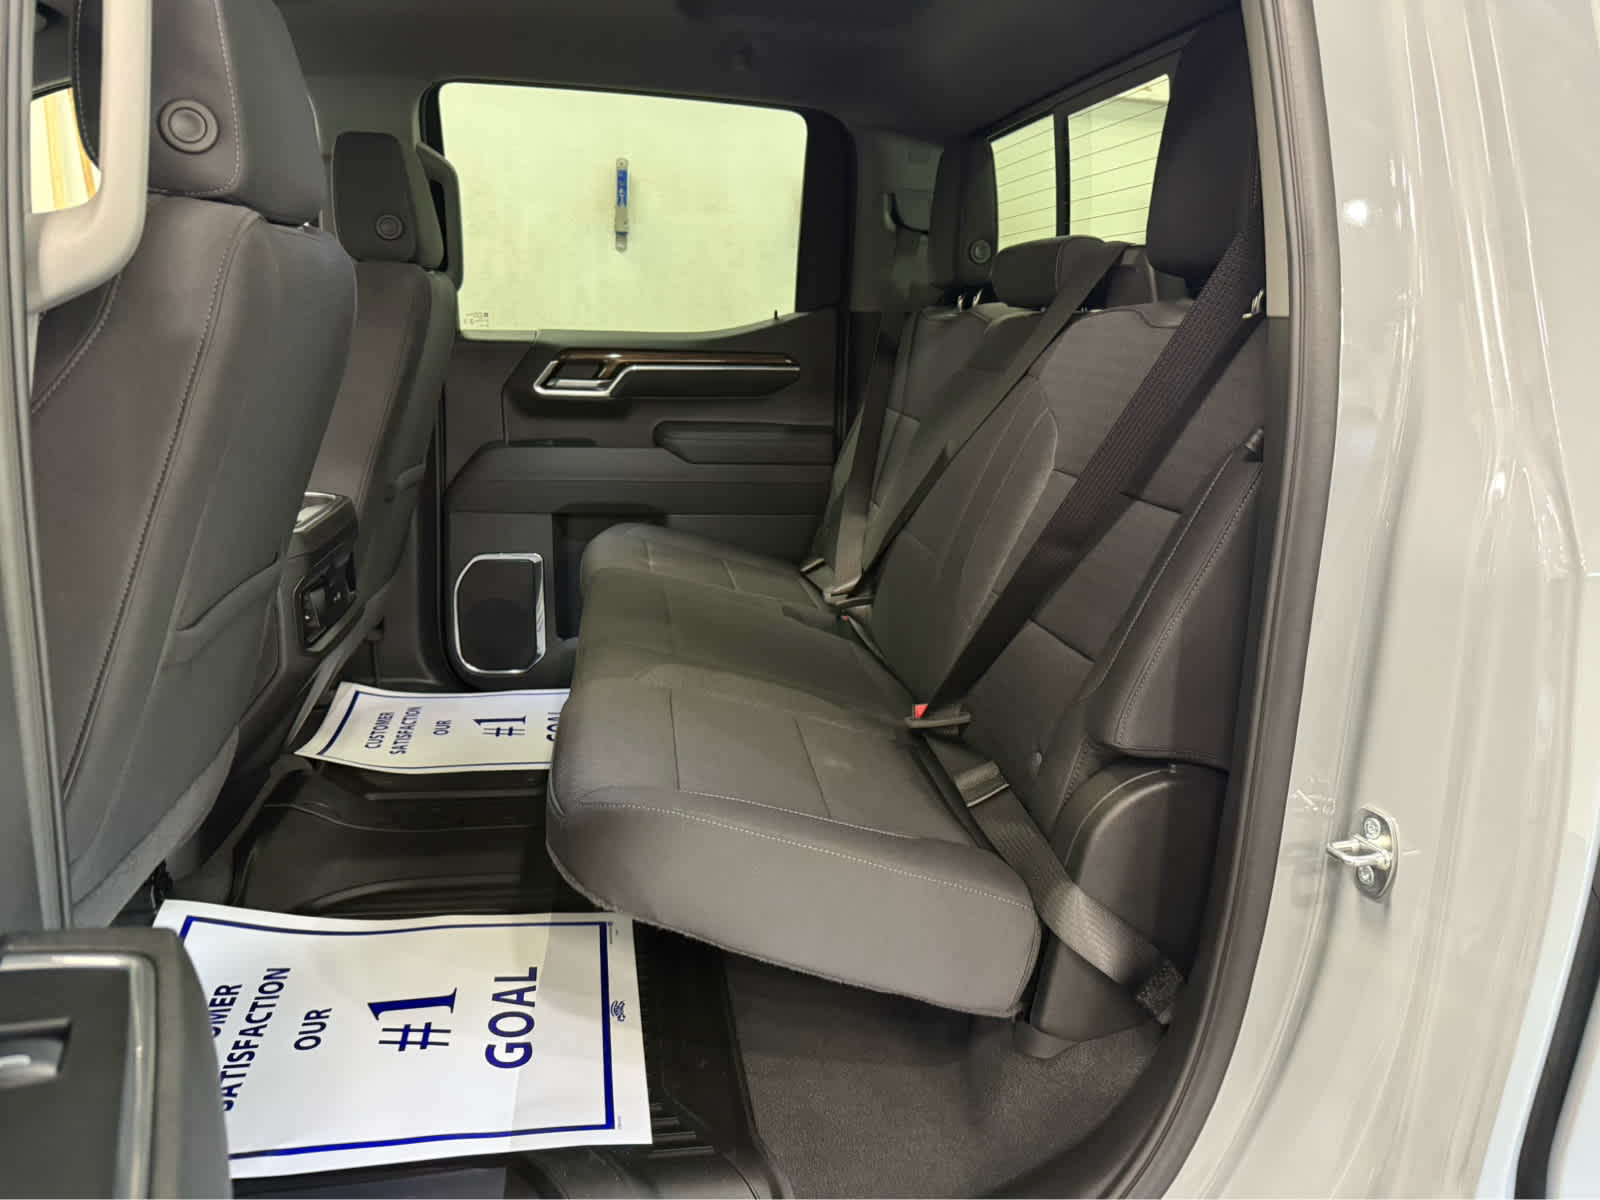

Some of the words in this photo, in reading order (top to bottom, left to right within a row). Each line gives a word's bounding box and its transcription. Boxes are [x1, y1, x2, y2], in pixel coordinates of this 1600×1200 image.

[364, 711, 395, 749] CUSTOMER
[389, 706, 422, 755] SATISFACTION
[433, 719, 452, 736] OUR
[472, 715, 527, 737] #1
[294, 1008, 333, 1051] OUR
[367, 987, 458, 1052] #1
[484, 965, 538, 1070] GOAL
